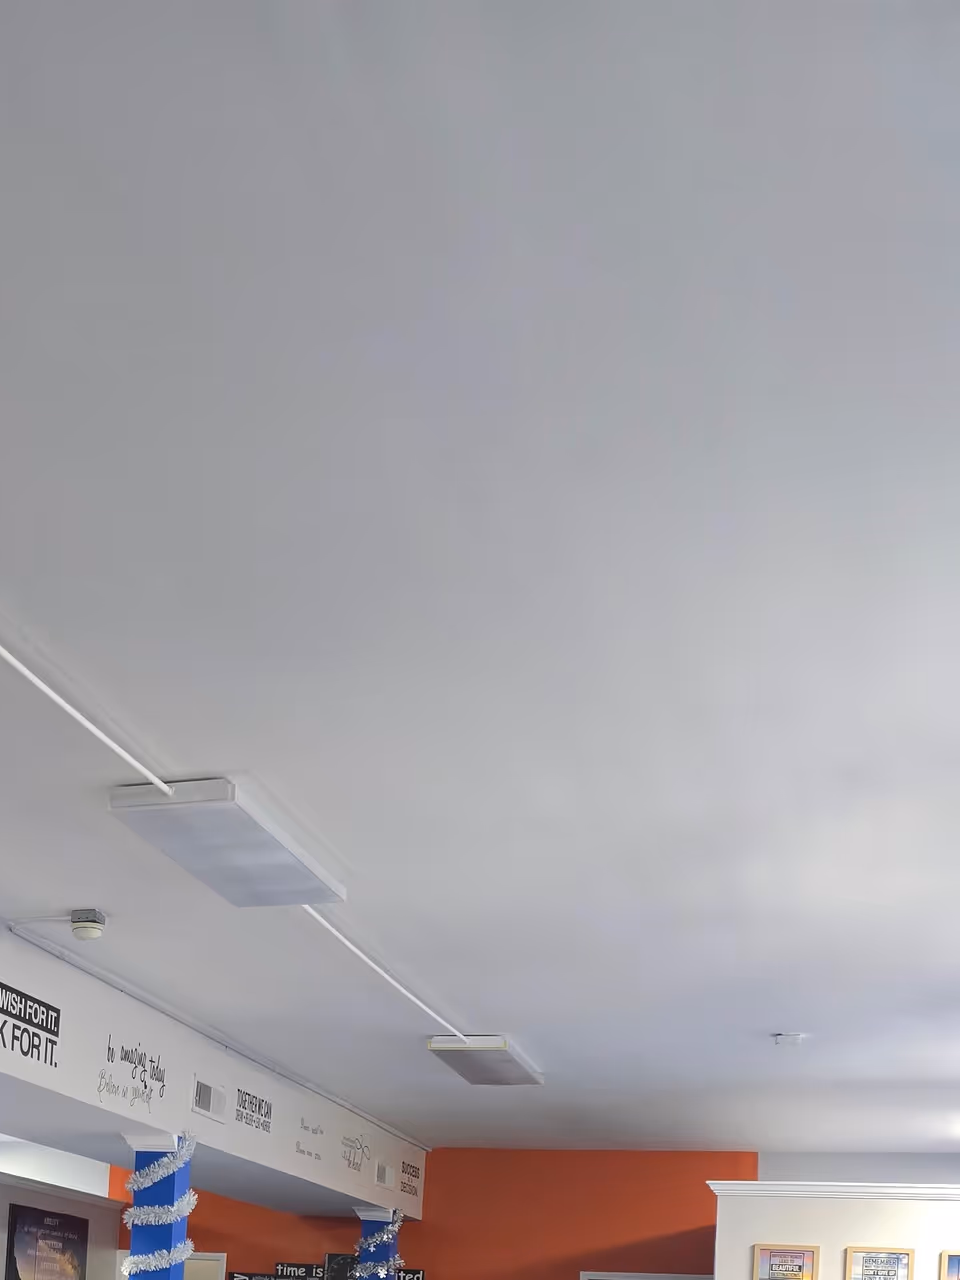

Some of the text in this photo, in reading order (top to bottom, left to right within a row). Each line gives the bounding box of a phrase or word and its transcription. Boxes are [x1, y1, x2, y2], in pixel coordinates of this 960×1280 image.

[25, 1000, 47, 1027] FOR
[47, 1010, 58, 1032] IT.
[11, 1022, 42, 1061] FOR
[44, 1036, 58, 1068] IT.
[106, 1034, 166, 1098] be amazing today
[236, 1088, 258, 1114] TOGETHER
[276, 1264, 306, 1276] time
[313, 1265, 324, 1277] is
